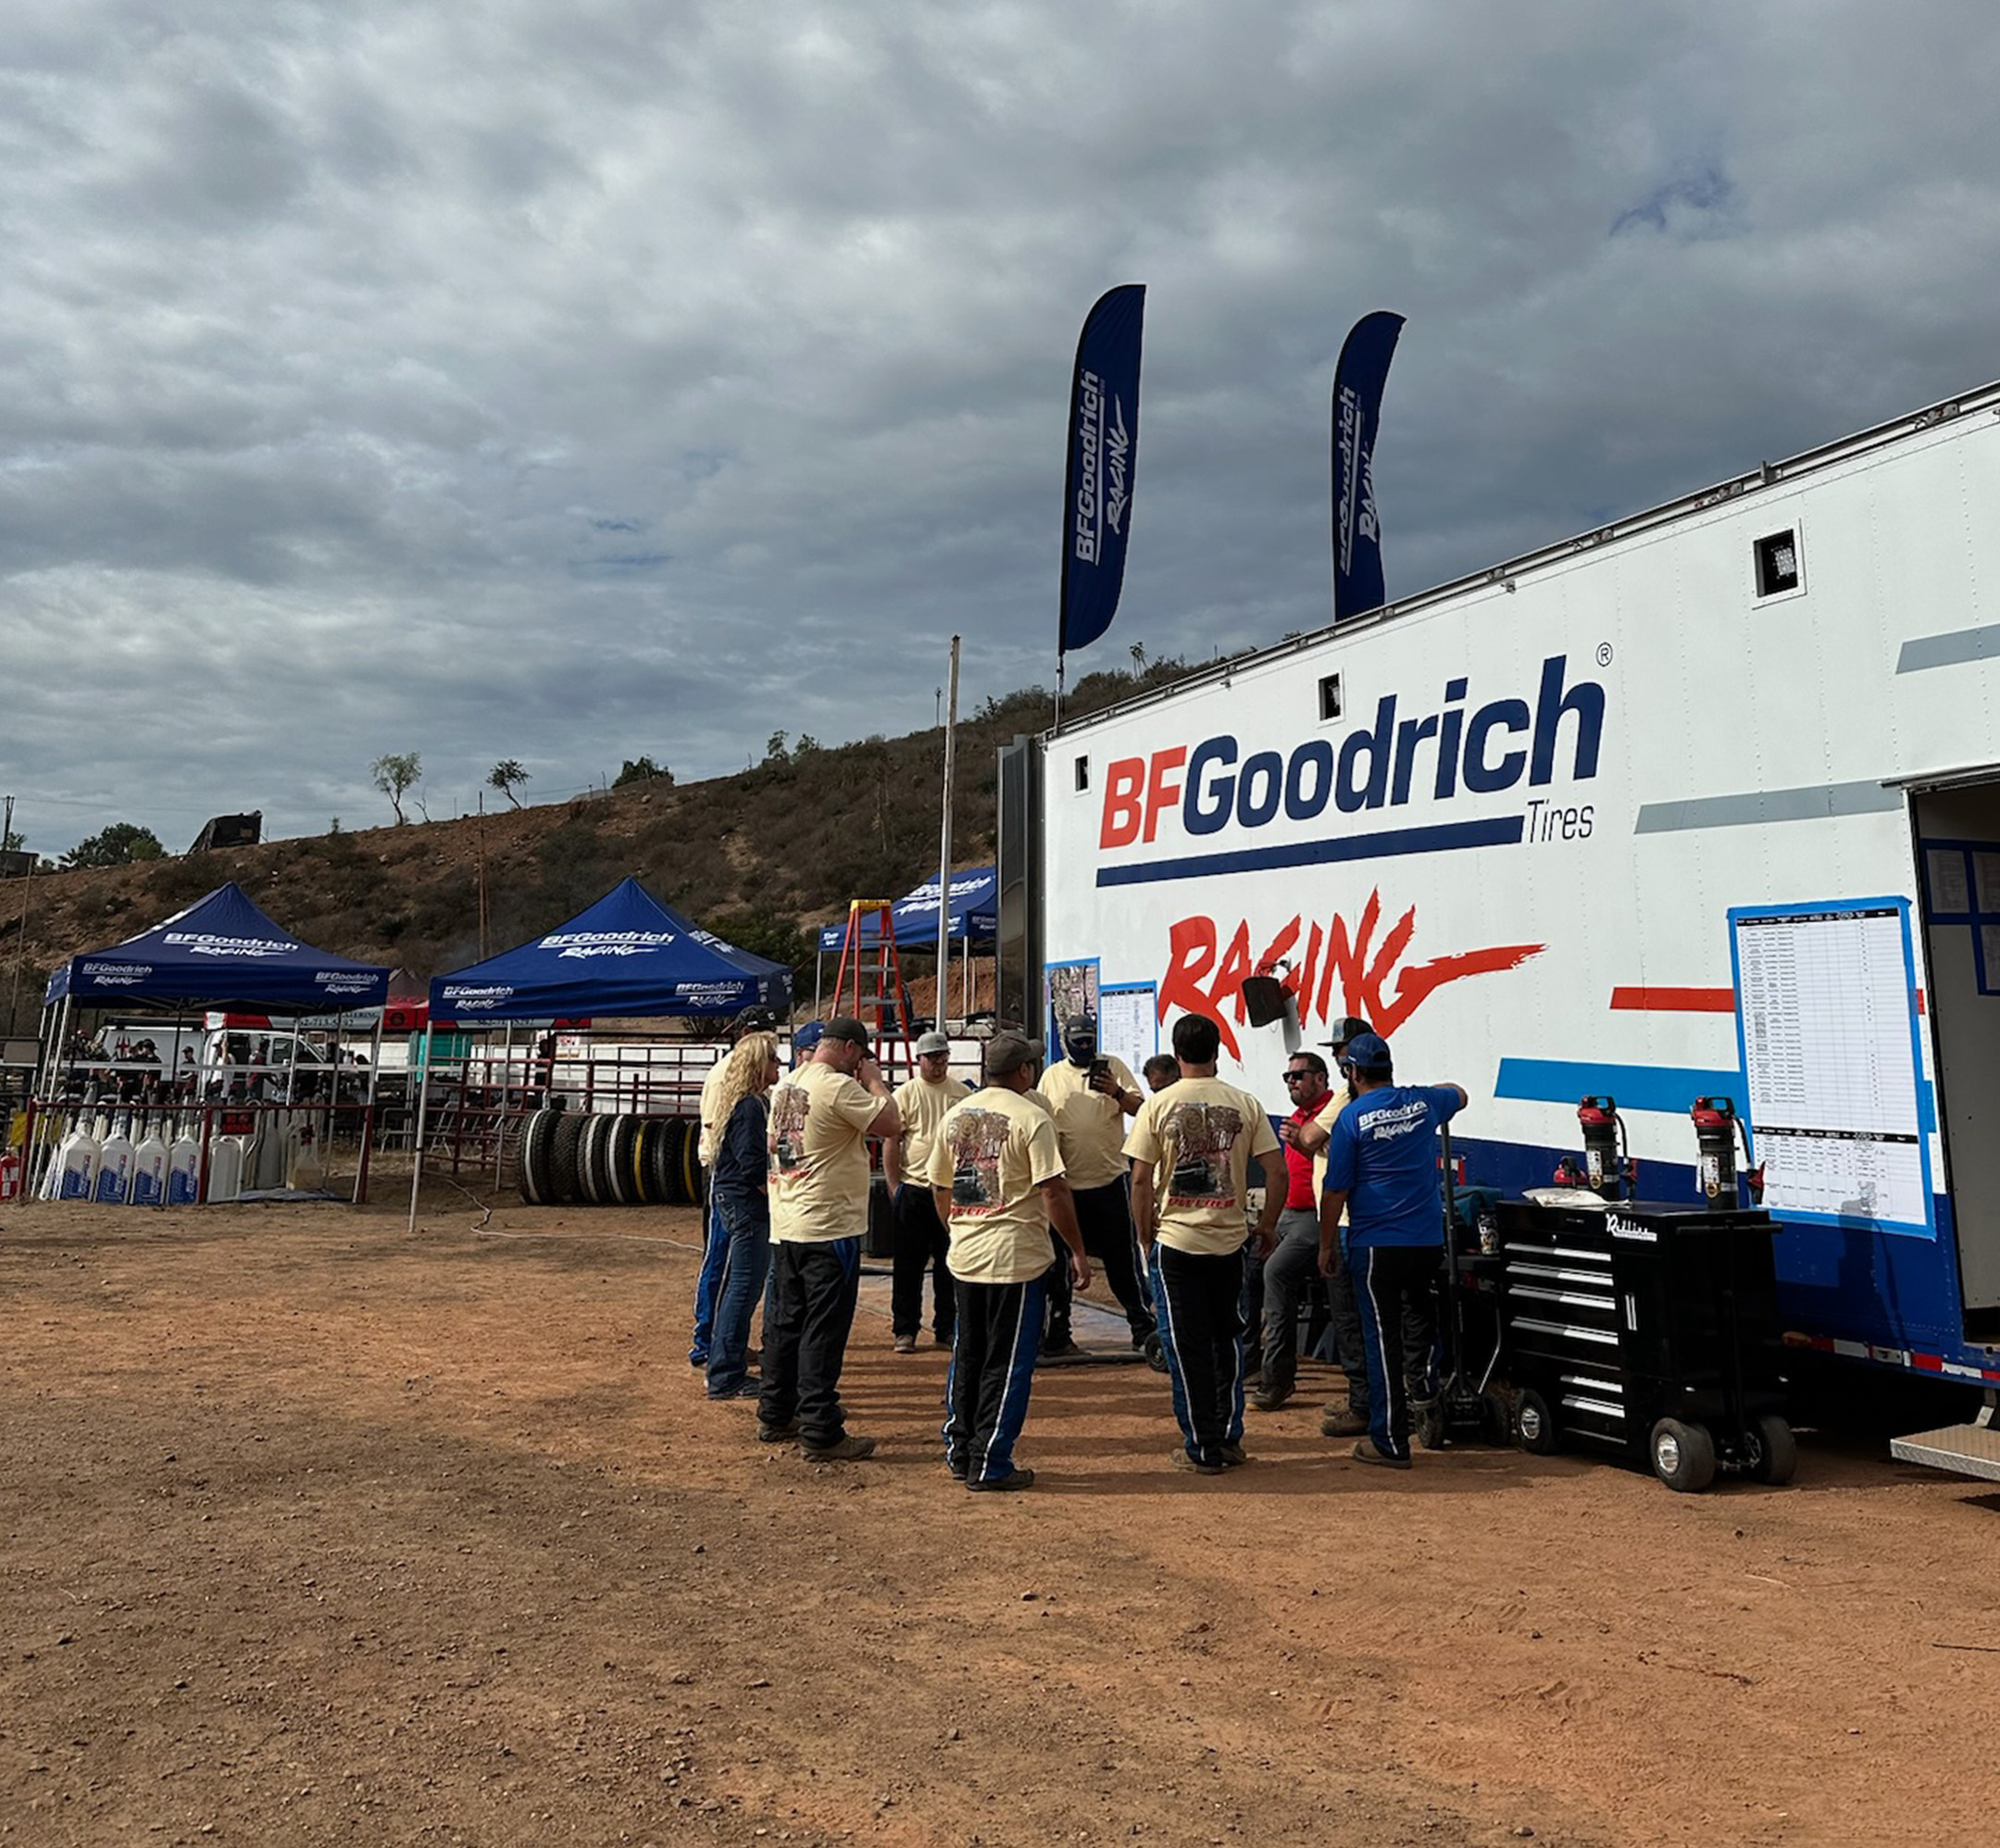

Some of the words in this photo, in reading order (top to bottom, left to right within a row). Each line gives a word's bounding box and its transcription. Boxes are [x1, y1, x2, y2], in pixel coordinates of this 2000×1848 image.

[1076, 370, 1099, 564] BFGoodrich
[1106, 393, 1129, 535] RACING
[1099, 655, 1606, 849] BFGoodrich
[1528, 799, 1594, 843] Tires
[165, 932, 299, 951] BFGoodrich
[541, 931, 675, 946] BFGoodrich
[189, 945, 289, 957] RACING
[558, 943, 659, 959] RACING
[82, 963, 153, 973] BFGoodrich
[315, 972, 380, 982] BFGoodrich
[1158, 884, 1549, 1070] RACING
[444, 985, 514, 996] BFGoodrich
[676, 981, 746, 993] BFGoodrich
